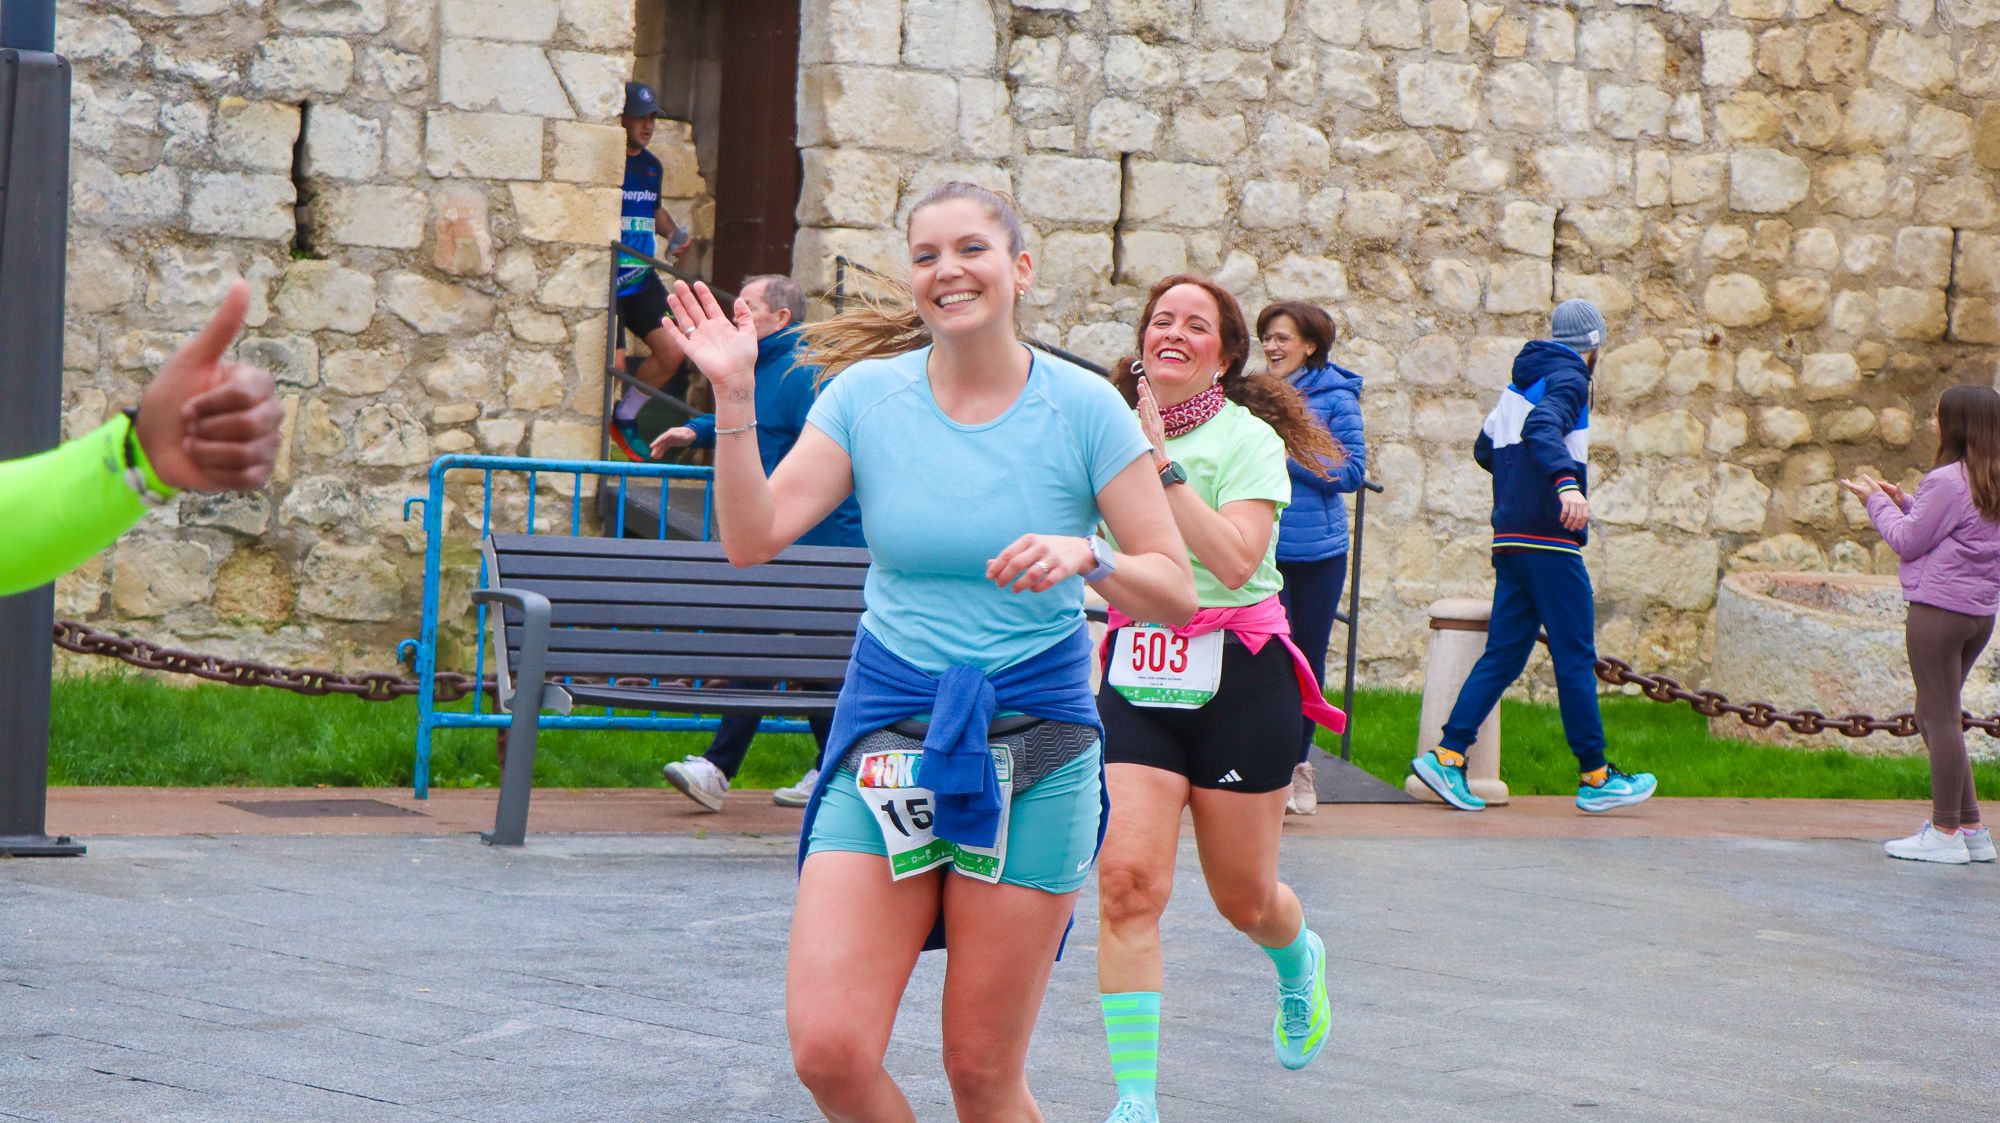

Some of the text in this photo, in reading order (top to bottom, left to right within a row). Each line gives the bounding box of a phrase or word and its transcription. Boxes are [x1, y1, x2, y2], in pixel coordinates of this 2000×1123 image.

[1132, 631, 1189, 673] 503
[872, 755, 915, 787] 10K
[880, 798, 933, 837] 15
